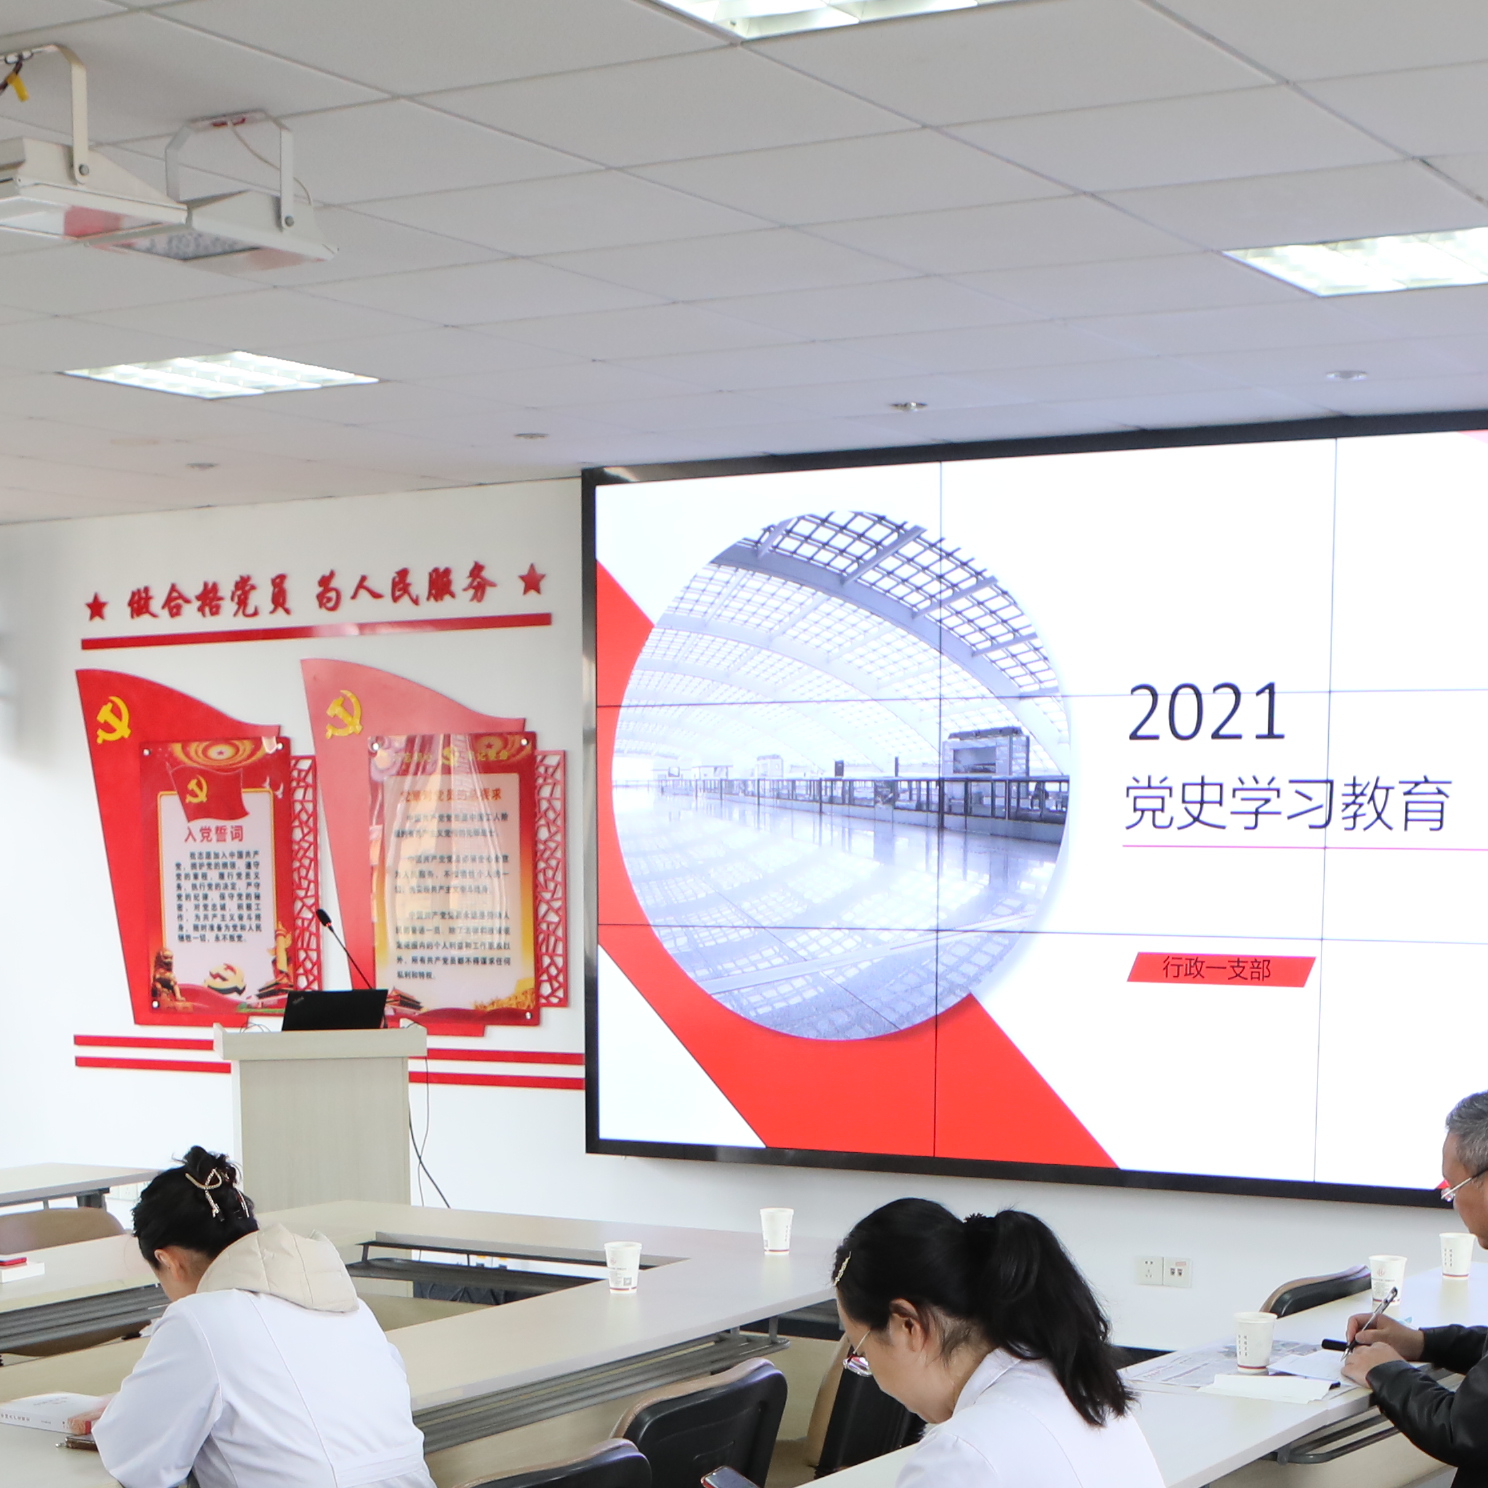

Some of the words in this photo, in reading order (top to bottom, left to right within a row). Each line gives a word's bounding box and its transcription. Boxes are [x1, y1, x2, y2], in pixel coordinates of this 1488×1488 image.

[128, 574, 290, 618] 做合格党员
[317, 563, 495, 610] 为人民服务
[1128, 681, 1285, 741] 2021
[1124, 775, 1453, 832] 党史学习教育
[184, 825, 244, 843] 入党誓词
[1162, 956, 1272, 982] 行政一支部
